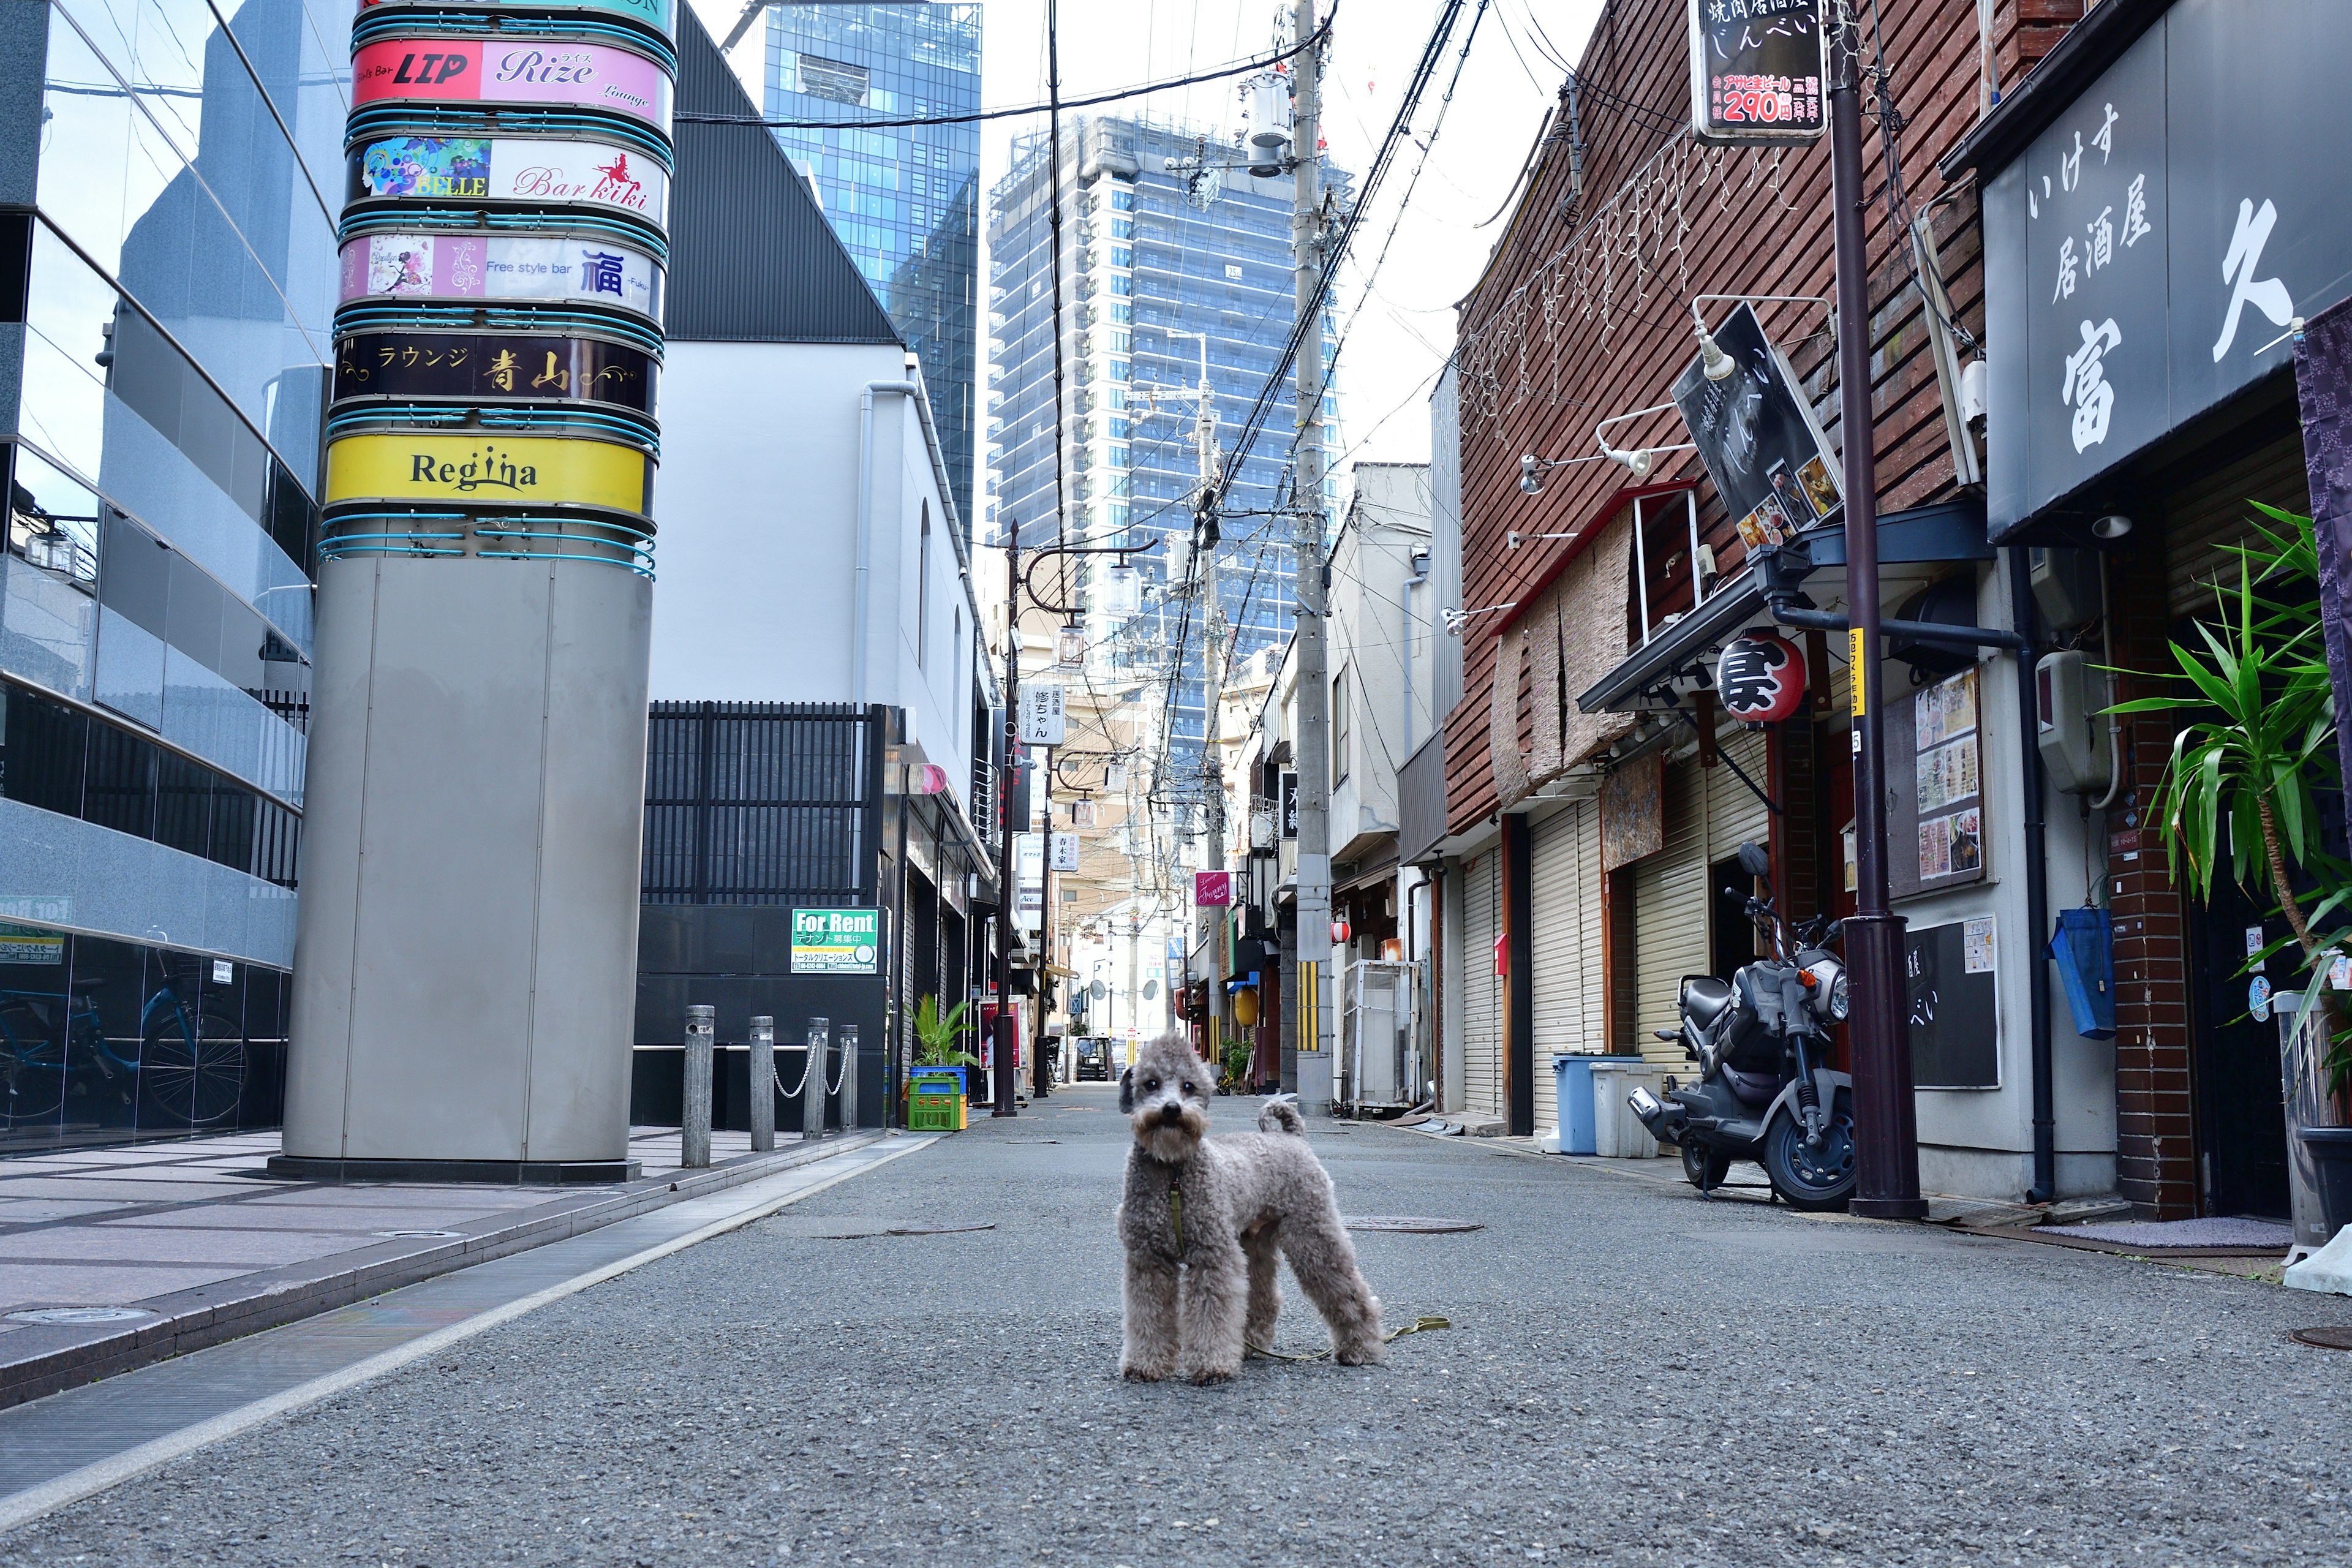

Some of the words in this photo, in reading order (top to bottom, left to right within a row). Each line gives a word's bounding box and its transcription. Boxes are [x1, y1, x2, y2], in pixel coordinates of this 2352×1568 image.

[1711, 14, 1817, 59] じんべい
[375, 65, 393, 77] Bar
[392, 53, 468, 84] LIP
[495, 50, 598, 85] Rize
[560, 53, 592, 64] ライズ
[1724, 74, 1791, 92] アサヒ生ビール
[598, 84, 649, 108] Lounge
[1712, 75, 1722, 119] 会員様
[2029, 103, 2119, 219] いけす
[417, 176, 486, 197] BELLE
[513, 166, 587, 197] Bar
[589, 175, 647, 211] kiki
[2052, 173, 2151, 305] 居酒屋
[371, 252, 398, 265] Papillon
[486, 261, 516, 274] Free
[518, 261, 548, 277] style
[551, 262, 573, 275] bar
[581, 248, 624, 298] 福
[627, 276, 649, 291] -Fuku-
[377, 345, 469, 368] ラウンジ
[483, 349, 570, 392] 青山
[410, 447, 537, 493] Regina
[1035, 691, 1049, 737] 修ちゃん
[1052, 690, 1060, 715] 居酒屋
[1058, 837, 1067, 864] 春木家
[1199, 873, 1218, 886] Lounge
[1198, 881, 1227, 905] Funny
[797, 913, 826, 932] For
[830, 913, 873, 933] Rent
[796, 934, 862, 944] テナント募集中
[794, 953, 853, 962] トータルクリエーションズ
